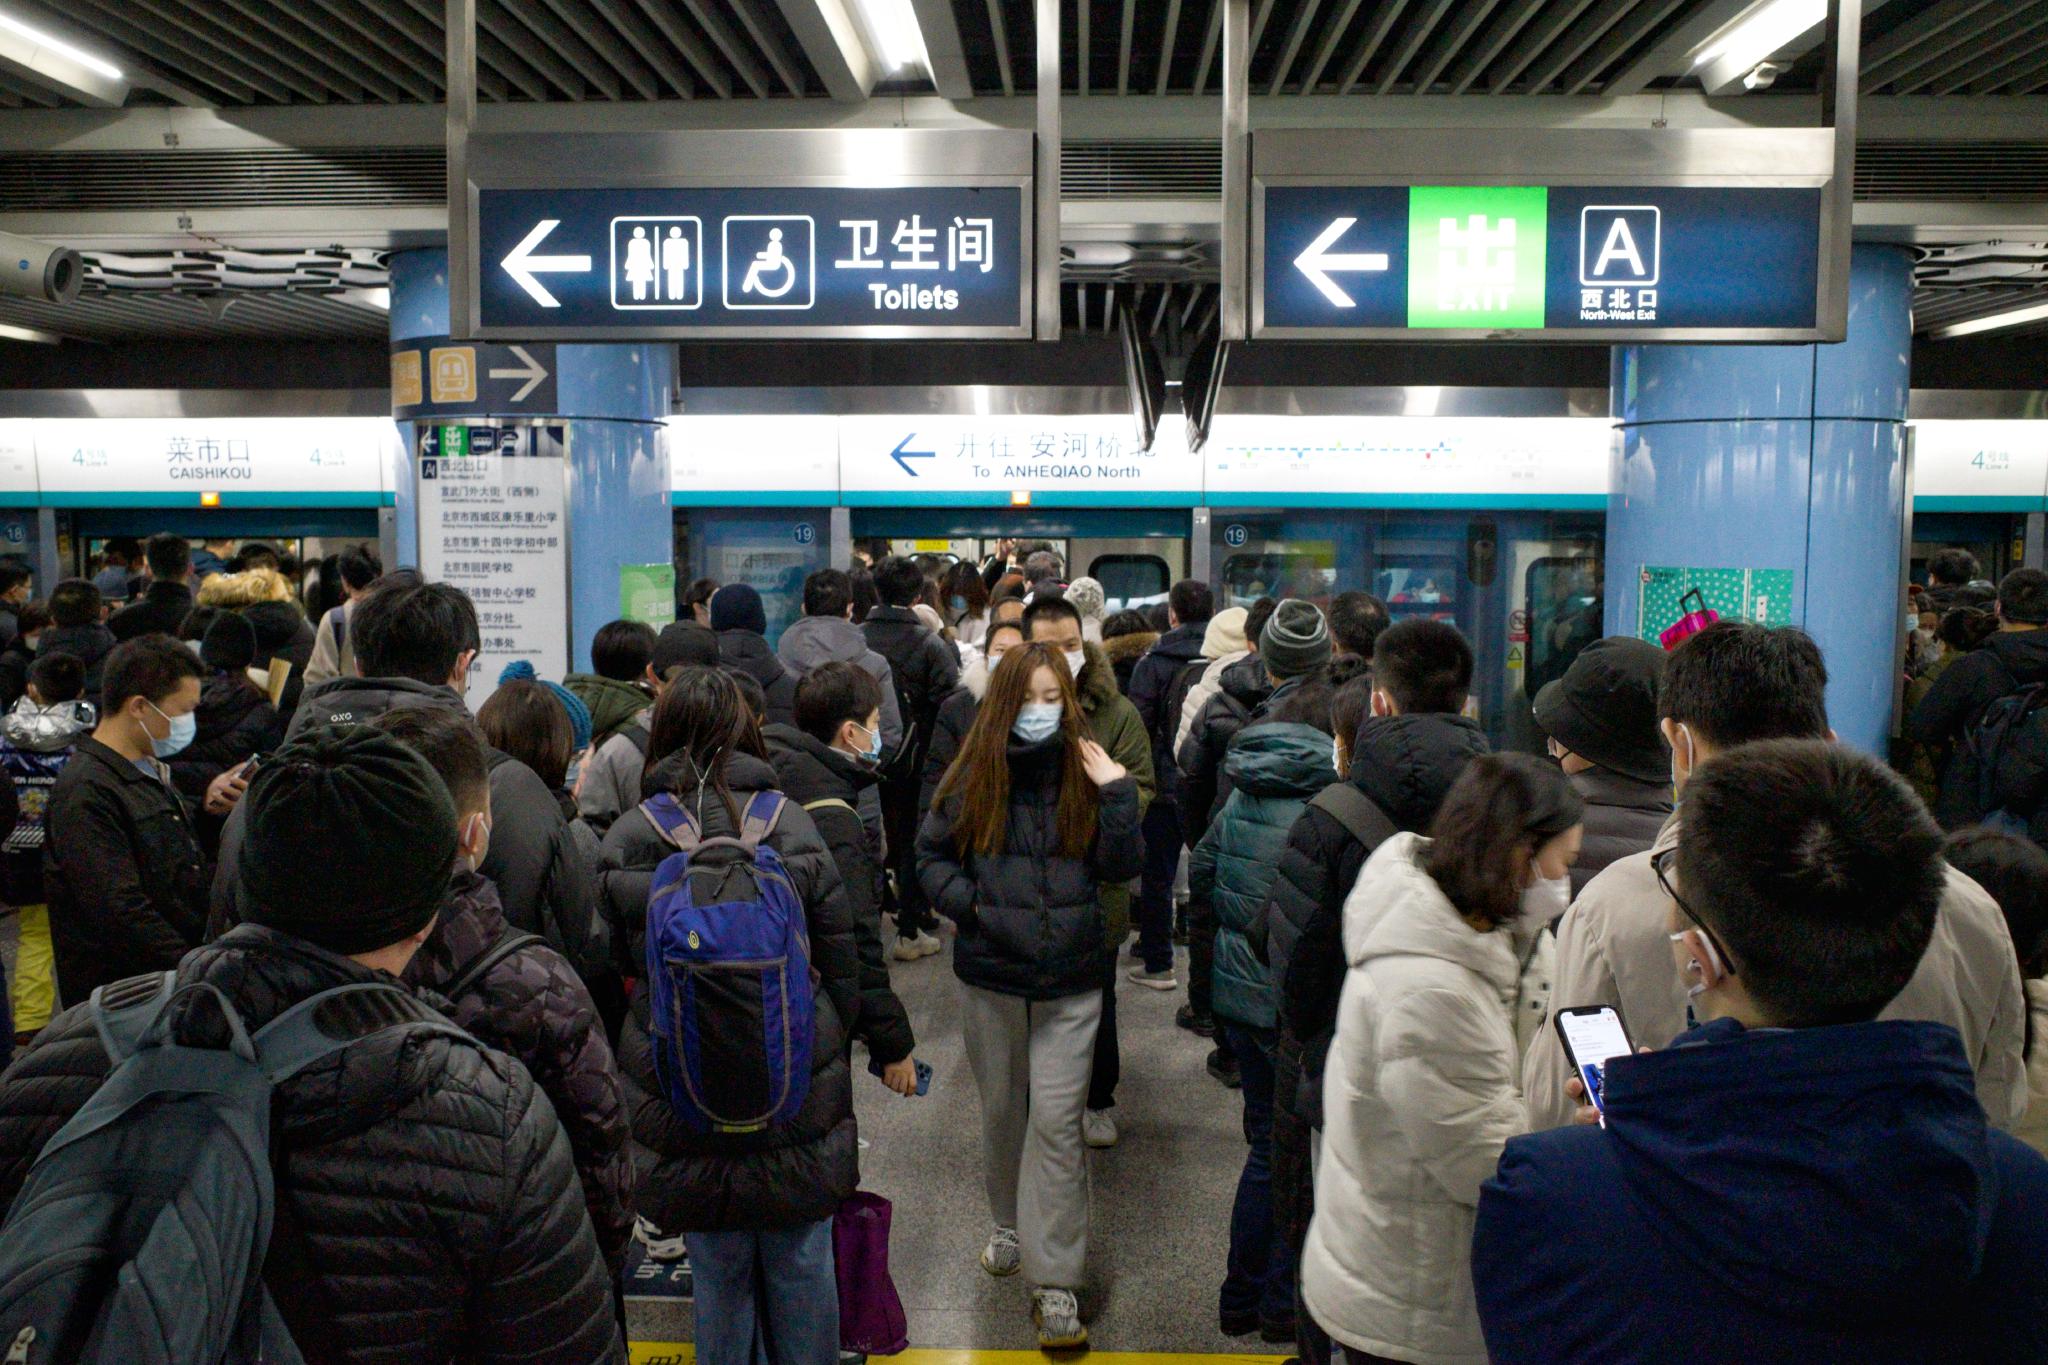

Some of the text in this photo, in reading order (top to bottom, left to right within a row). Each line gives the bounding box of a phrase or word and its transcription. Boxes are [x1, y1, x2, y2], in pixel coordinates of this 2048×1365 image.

[835, 214, 993, 273] 卫生间
[1439, 214, 1517, 285] 出
[1593, 217, 1646, 276] A
[868, 283, 959, 310] Toilets
[1580, 288, 1657, 309] 西北口
[1580, 309, 1656, 321] North-West Exit
[167, 436, 251, 464] 菜市口
[169, 466, 252, 480] CAISHIKOU
[972, 464, 1141, 478] To ANHEQIAO North
[7, 526, 23, 540] 18
[795, 527, 812, 541] 19
[1228, 528, 1245, 543] 19
[484, 637, 515, 649] 办事处
